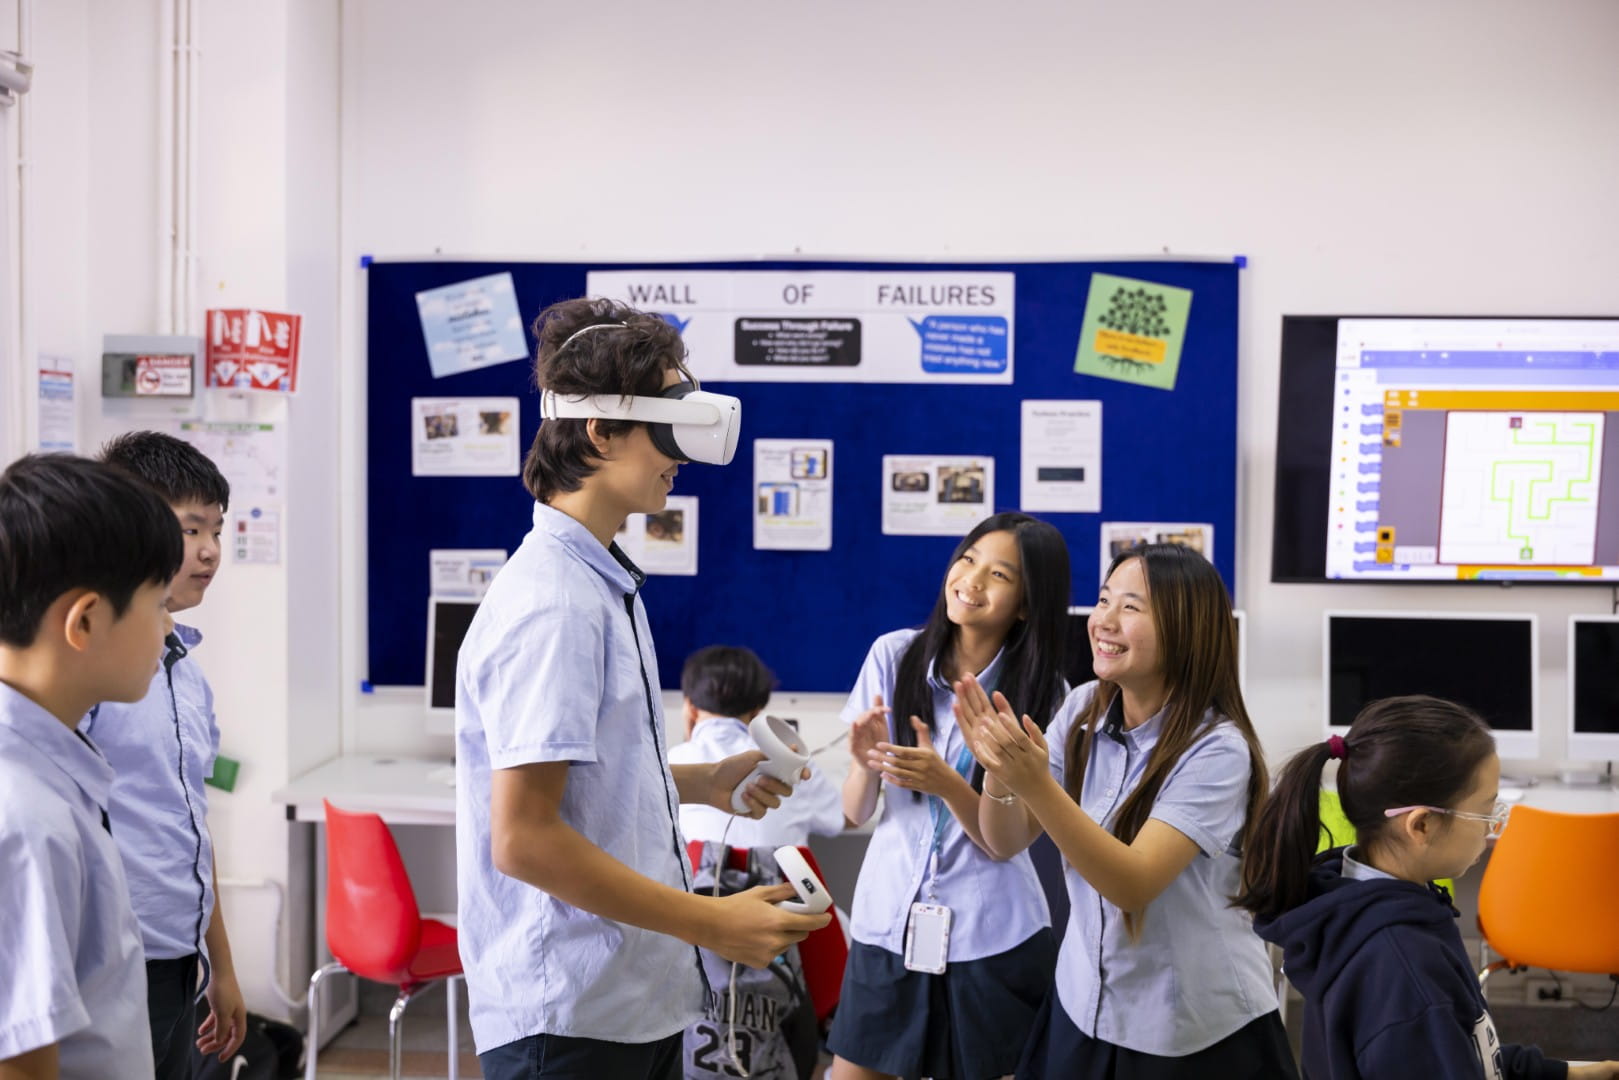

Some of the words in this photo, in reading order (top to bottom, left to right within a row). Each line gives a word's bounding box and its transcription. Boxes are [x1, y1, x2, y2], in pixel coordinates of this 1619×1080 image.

[628, 284, 697, 305] WALL
[782, 285, 815, 305] OF
[877, 284, 995, 305] FAILURES
[694, 1024, 752, 1079] 23
